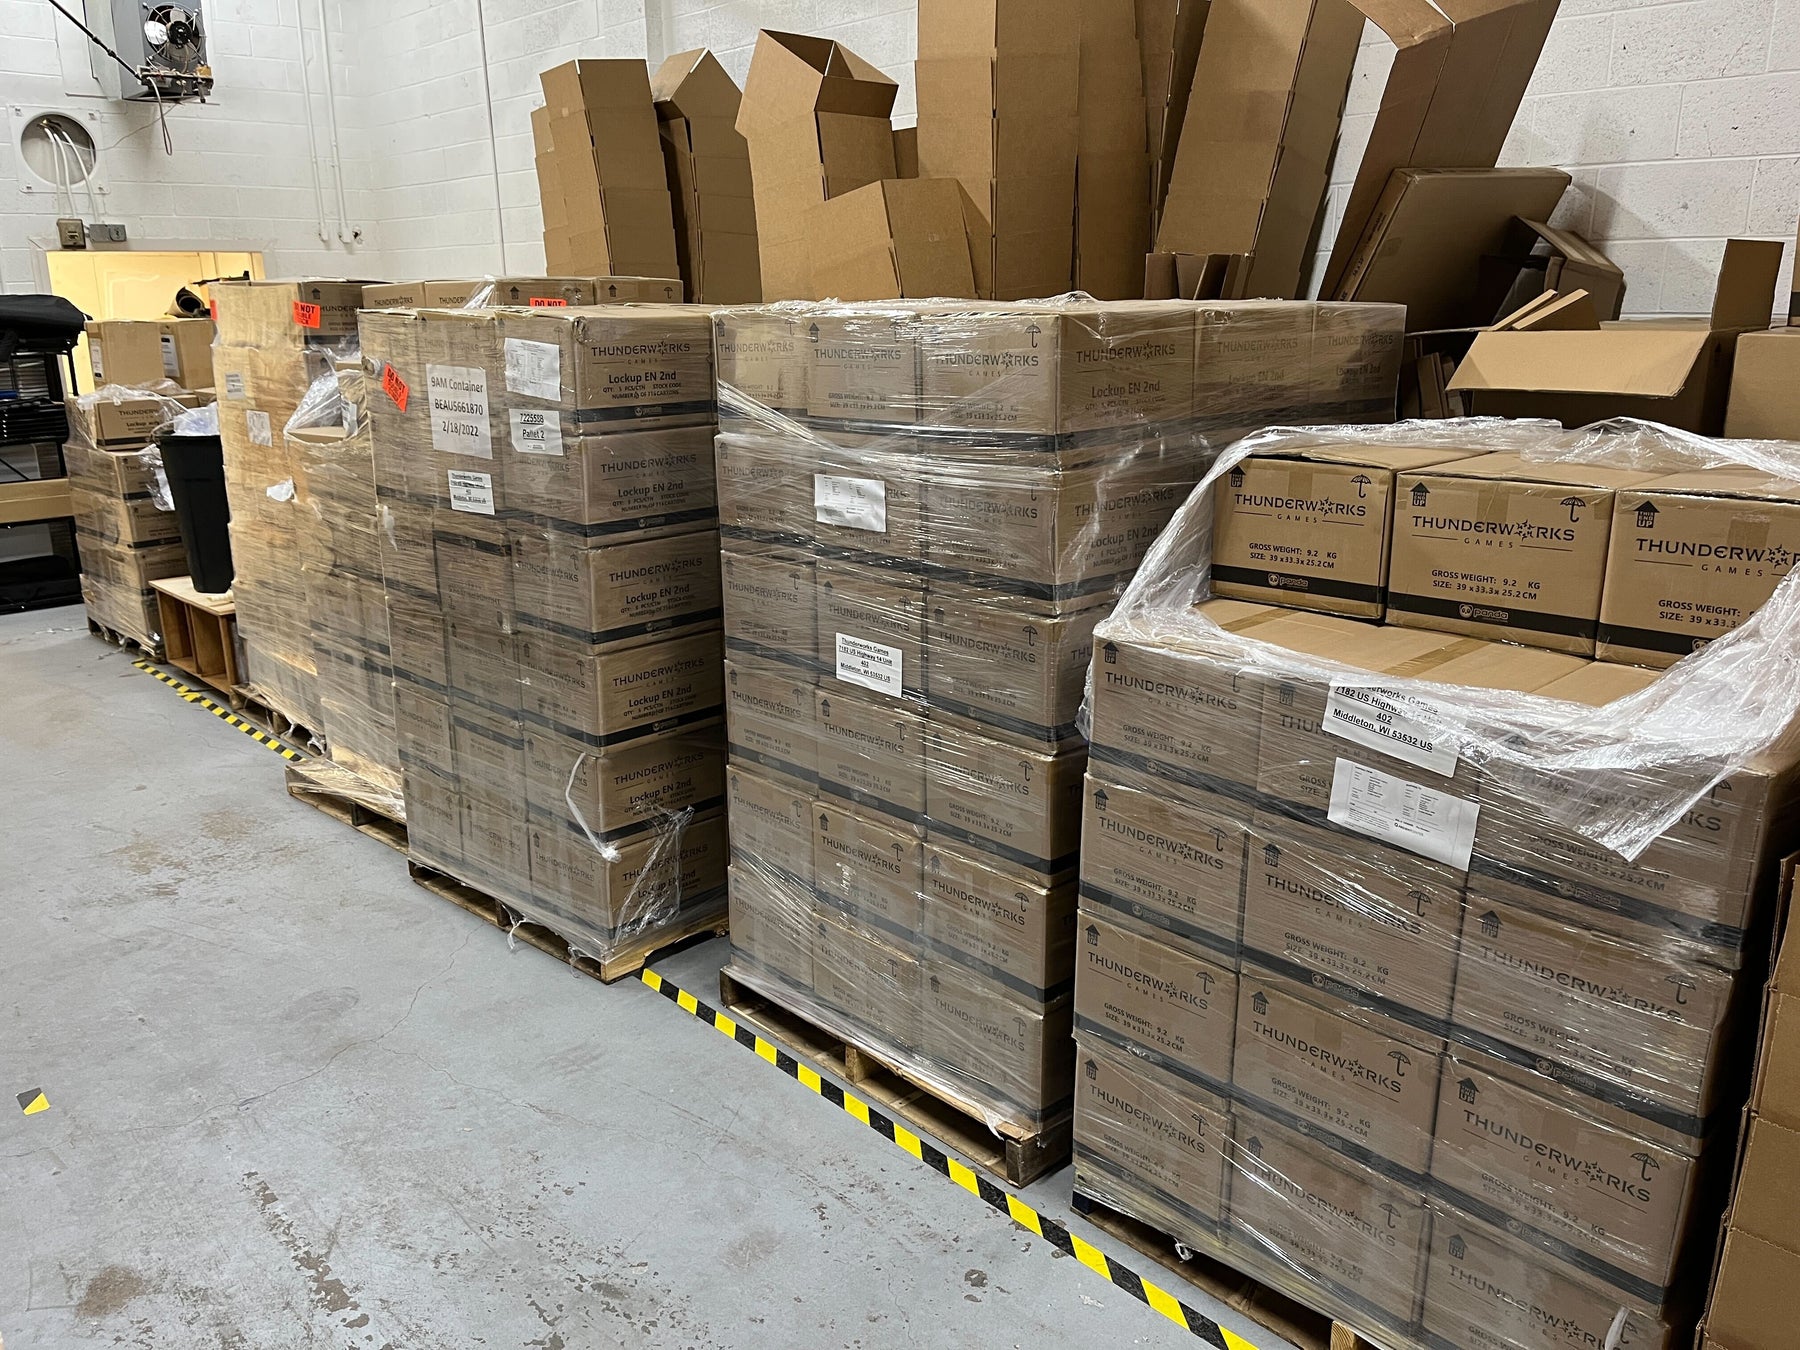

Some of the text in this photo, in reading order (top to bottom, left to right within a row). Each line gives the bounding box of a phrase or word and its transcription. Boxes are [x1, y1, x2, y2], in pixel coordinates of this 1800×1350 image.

[591, 341, 691, 357] THUNDERWORKS
[720, 340, 794, 353] THUNDERWORKS
[1076, 341, 1176, 363] THUNDERWORKS
[431, 376, 483, 392] 9AM Container
[609, 371, 676, 384] Lockup EN 2nd
[1092, 380, 1160, 398] Lockup EN 2nd
[435, 399, 483, 415] BEAU5661870
[443, 421, 479, 437] 2/18/2022
[601, 454, 697, 473] THUNDERWORKS
[618, 480, 683, 497] Lockup EN 2nd
[1235, 494, 1366, 517] THUNDERWORKS
[1277, 514, 1318, 523] GAMES
[1412, 515, 1575, 542] THUNDERWORKS
[1091, 524, 1158, 548] Lockup EN 2nd
[1464, 537, 1513, 548] GAMES
[1249, 543, 1271, 551] GROSS
[1273, 545, 1302, 555] WEIGHT:
[1250, 552, 1266, 560] SIZE:
[609, 557, 703, 582] THUNDERWORKS
[1431, 569, 1540, 590] GROSS WEIGHT: 9.2 KG
[1701, 564, 1763, 576] GAMES
[1280, 576, 1308, 586] panda
[1433, 580, 1452, 589] SIZE:
[626, 584, 689, 604] Lockup EN 2nd
[1473, 607, 1508, 620] panda
[1658, 600, 1741, 617] GROSS WEIGHT:
[1659, 611, 1683, 621] SIZE:
[629, 684, 692, 707] Lockup EN 2nd
[1105, 672, 1237, 710] THUNDERWORKS
[1335, 686, 1355, 698] 7182
[1357, 692, 1369, 702] US
[1376, 712, 1393, 724] 402
[824, 722, 904, 753] THUNDERWORKS
[1122, 725, 1144, 735] GROSS
[1147, 730, 1176, 744] WEIGHT:
[1333, 708, 1376, 732] Middleton,
[1379, 725, 1390, 735] WI
[1392, 729, 1418, 746] 53532
[1420, 741, 1433, 751] US
[630, 778, 692, 804] Lockup EN 2nd
[1300, 774, 1327, 788] GROSS
[1099, 816, 1224, 870] THUNDERWORKS
[821, 836, 901, 874] THUNDERWORKS
[1113, 868, 1135, 881] GROSS
[1136, 877, 1164, 892] WEIGHT:
[1187, 896, 1197, 905] KG
[932, 879, 1025, 925] THUNDERWORKS
[1284, 932, 1311, 946] GROSS
[1312, 939, 1347, 960] WEIGHT:
[1376, 965, 1389, 975] KG
[1088, 951, 1208, 1010] THUNDERWORKS
[1127, 982, 1164, 1002] GAMES
[1104, 1003, 1125, 1017] GROSS
[1125, 1012, 1153, 1030] WEIGHT:
[1175, 1034, 1185, 1044] KG
[1106, 1012, 1119, 1023] SIZE:
[1503, 1011, 1537, 1029] GROSS
[1504, 1023, 1528, 1038] SIZE:
[1253, 1021, 1401, 1093] THUNDERWORKS
[1553, 1068, 1596, 1090] panda
[1271, 1077, 1371, 1129] GROSS WEIGHT: 9.2 KG
[1090, 1084, 1205, 1154] THUNDERWORKS
[1463, 1109, 1651, 1203] THUNDERWORKS
[1523, 1154, 1580, 1186] GAMES
[1563, 1211, 1579, 1224] 9.2
[1590, 1223, 1606, 1236] KG
